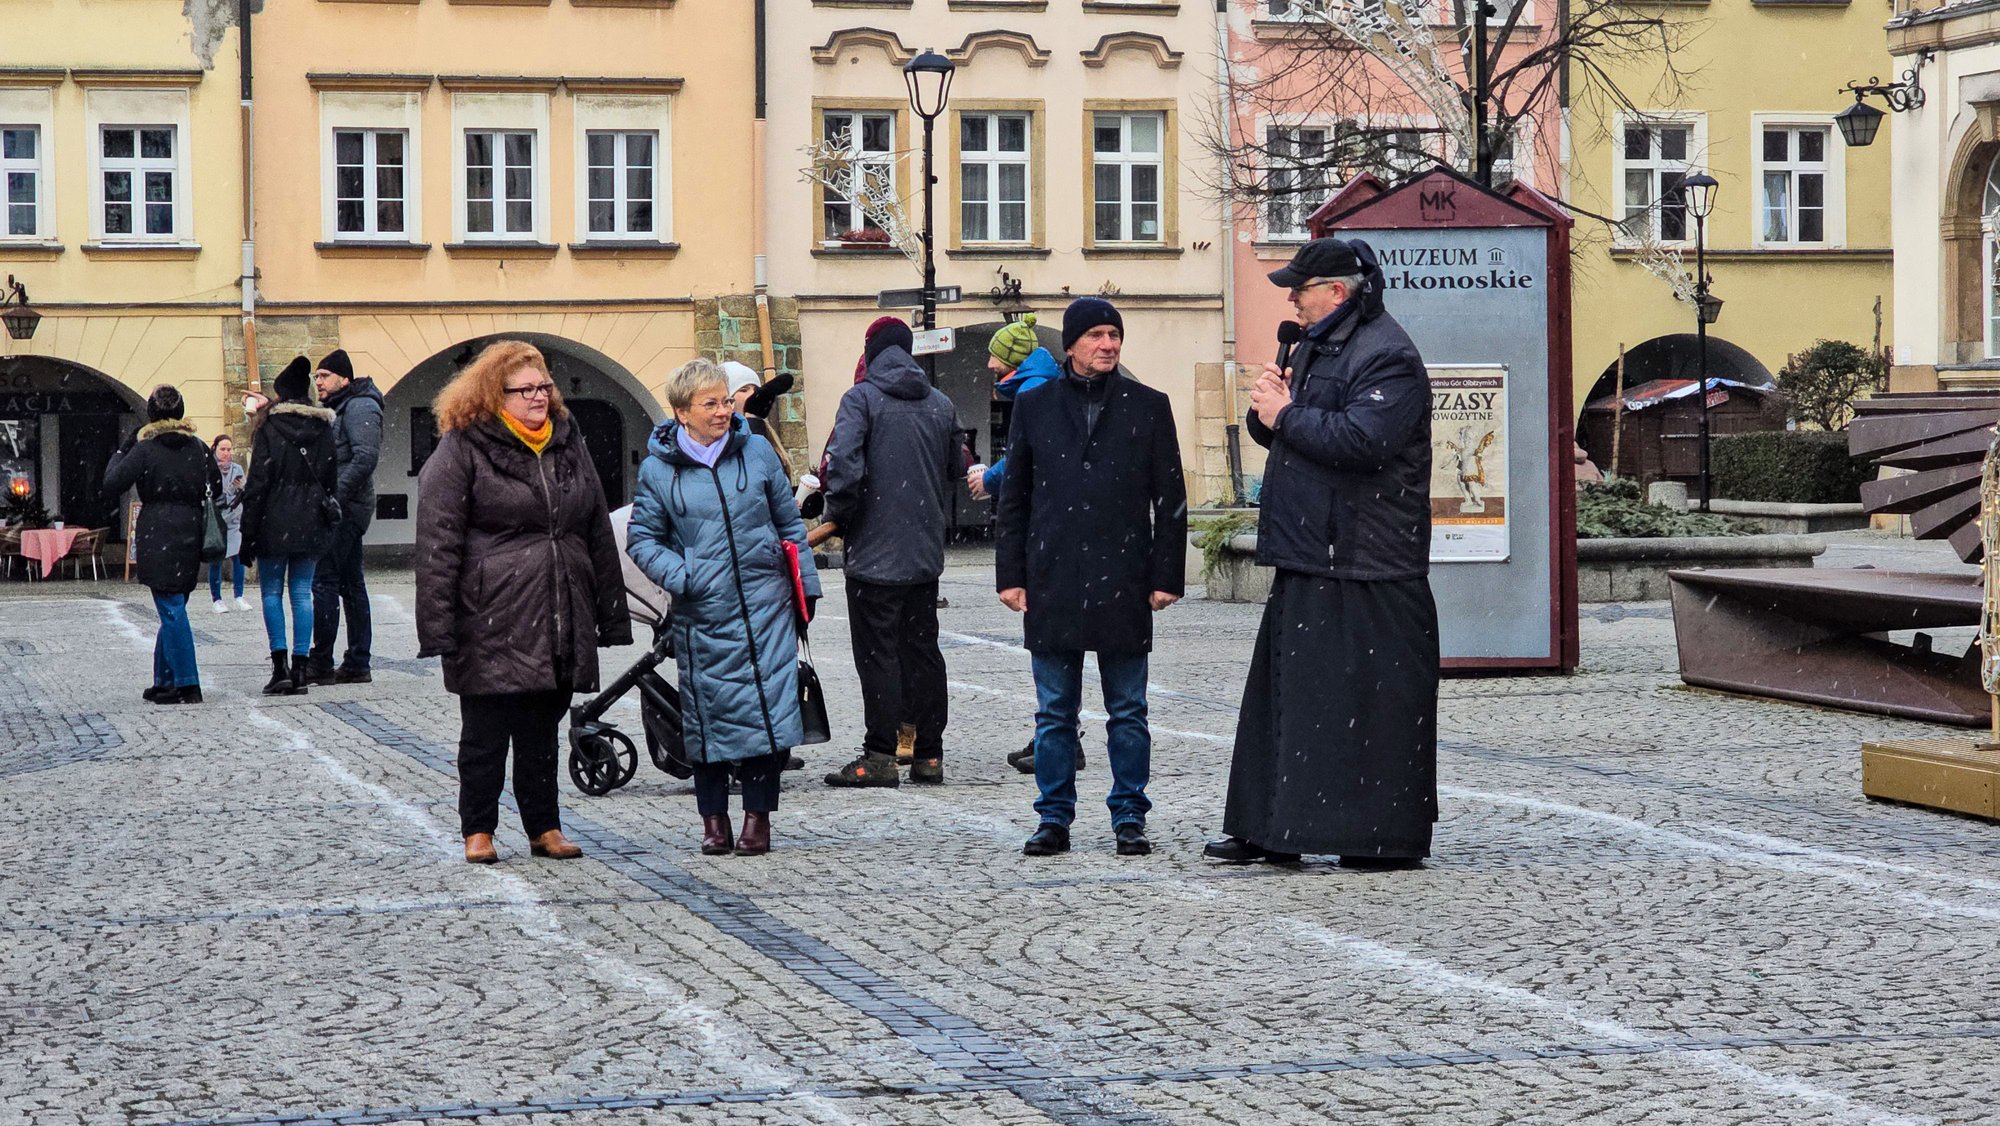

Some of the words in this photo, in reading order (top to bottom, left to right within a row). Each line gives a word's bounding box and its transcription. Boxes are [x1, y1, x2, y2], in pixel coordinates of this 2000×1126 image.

[1419, 191, 1457, 211] MK
[1379, 248, 1478, 266] MUZEUM
[1382, 270, 1533, 290] rkonoskie
[5, 396, 72, 411] ACJA
[1432, 411, 1493, 420] OWOŻYTNE
